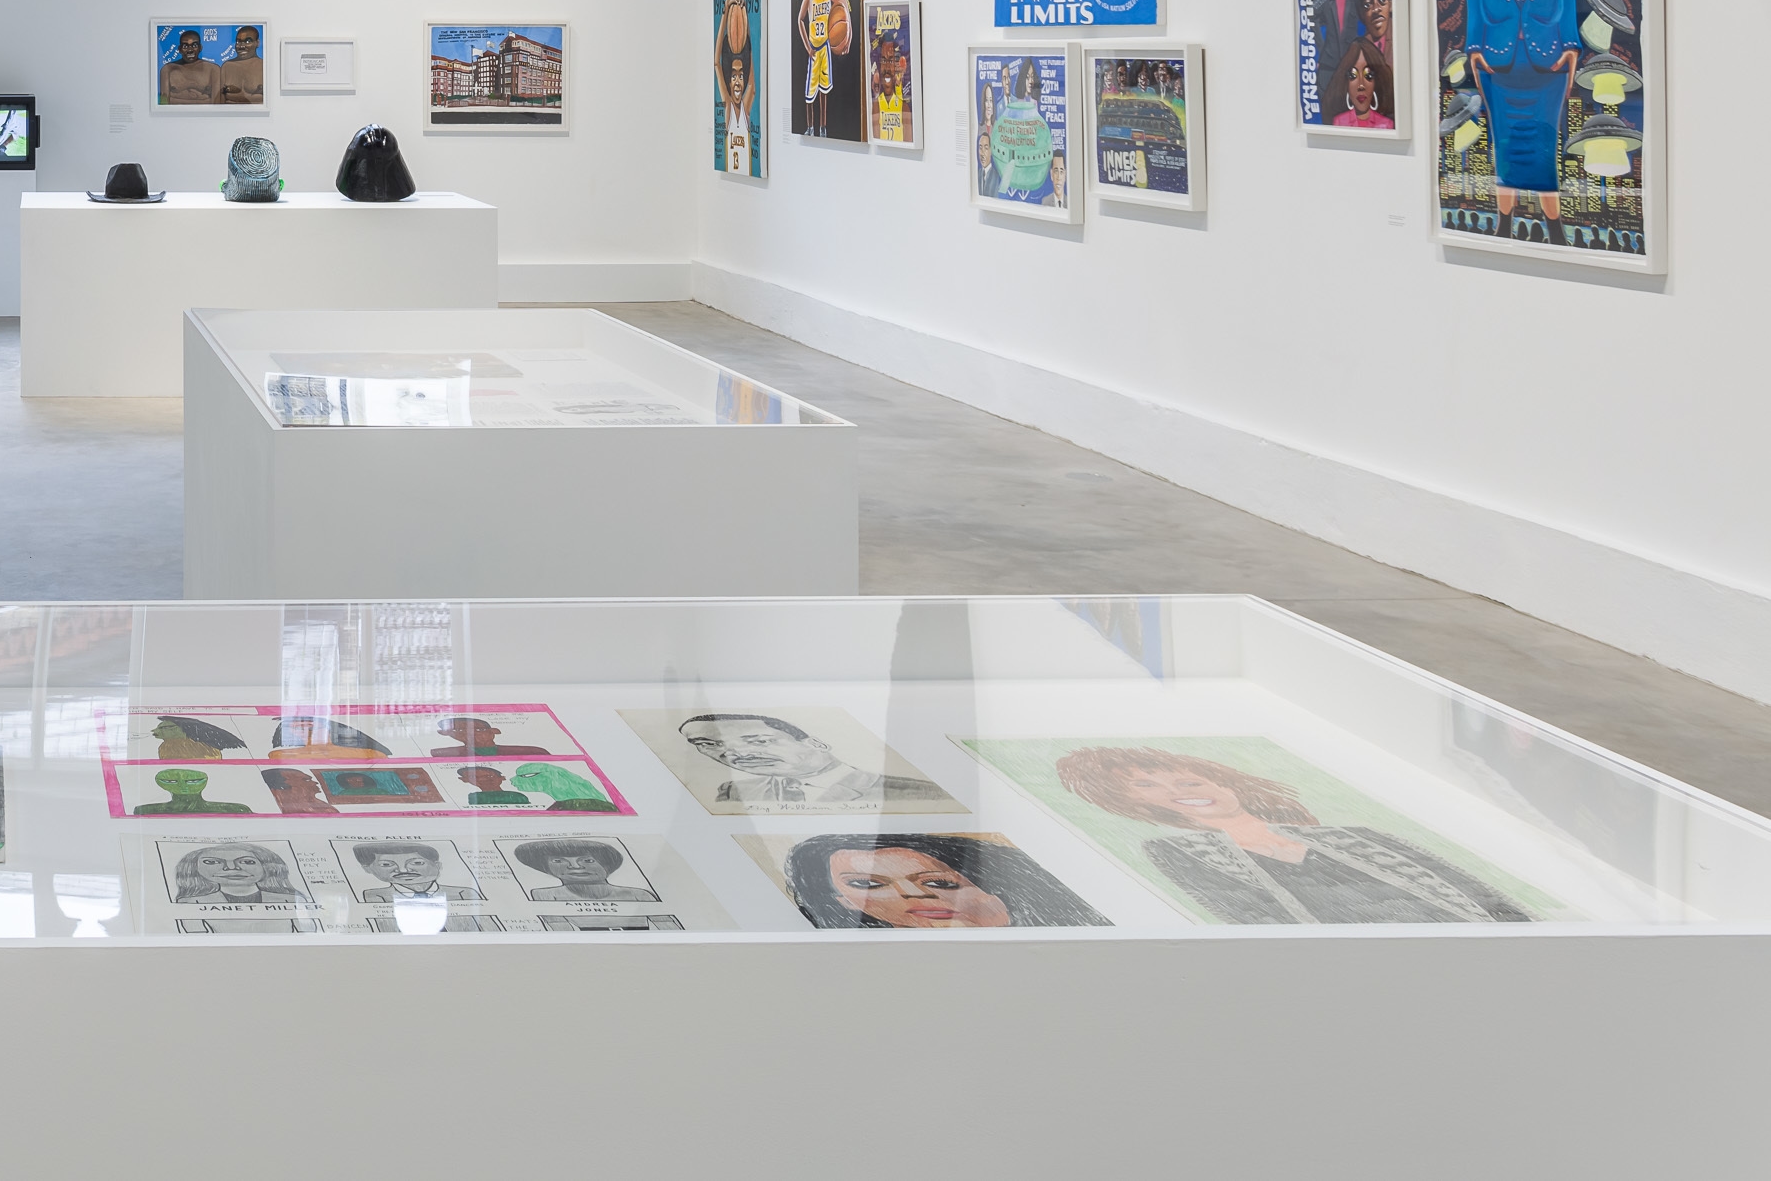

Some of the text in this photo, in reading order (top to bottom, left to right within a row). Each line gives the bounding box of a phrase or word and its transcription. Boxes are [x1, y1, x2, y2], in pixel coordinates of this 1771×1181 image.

[812, 2, 830, 22] LAKERS
[1010, 1, 1095, 25] LIMITS
[875, 7, 901, 35] LAKERS
[815, 22, 825, 38] 32
[978, 60, 1002, 71] RETURN
[979, 71, 997, 80] OF THE
[1041, 69, 1057, 78] NEW
[1041, 80, 1059, 94] 20TH
[881, 111, 901, 130] LAKERS
[1045, 111, 1065, 123] PEACE
[1016, 126, 1037, 136] FRIENDLY
[1051, 128, 1066, 137] PEOPLE
[730, 132, 745, 149] LAKERS
[751, 135, 759, 147] THE
[999, 135, 1036, 147] ORGANIZATIONS
[751, 148, 759, 159] KID
[1103, 149, 1137, 171] INNER
[1108, 169, 1137, 185] LIMITS
